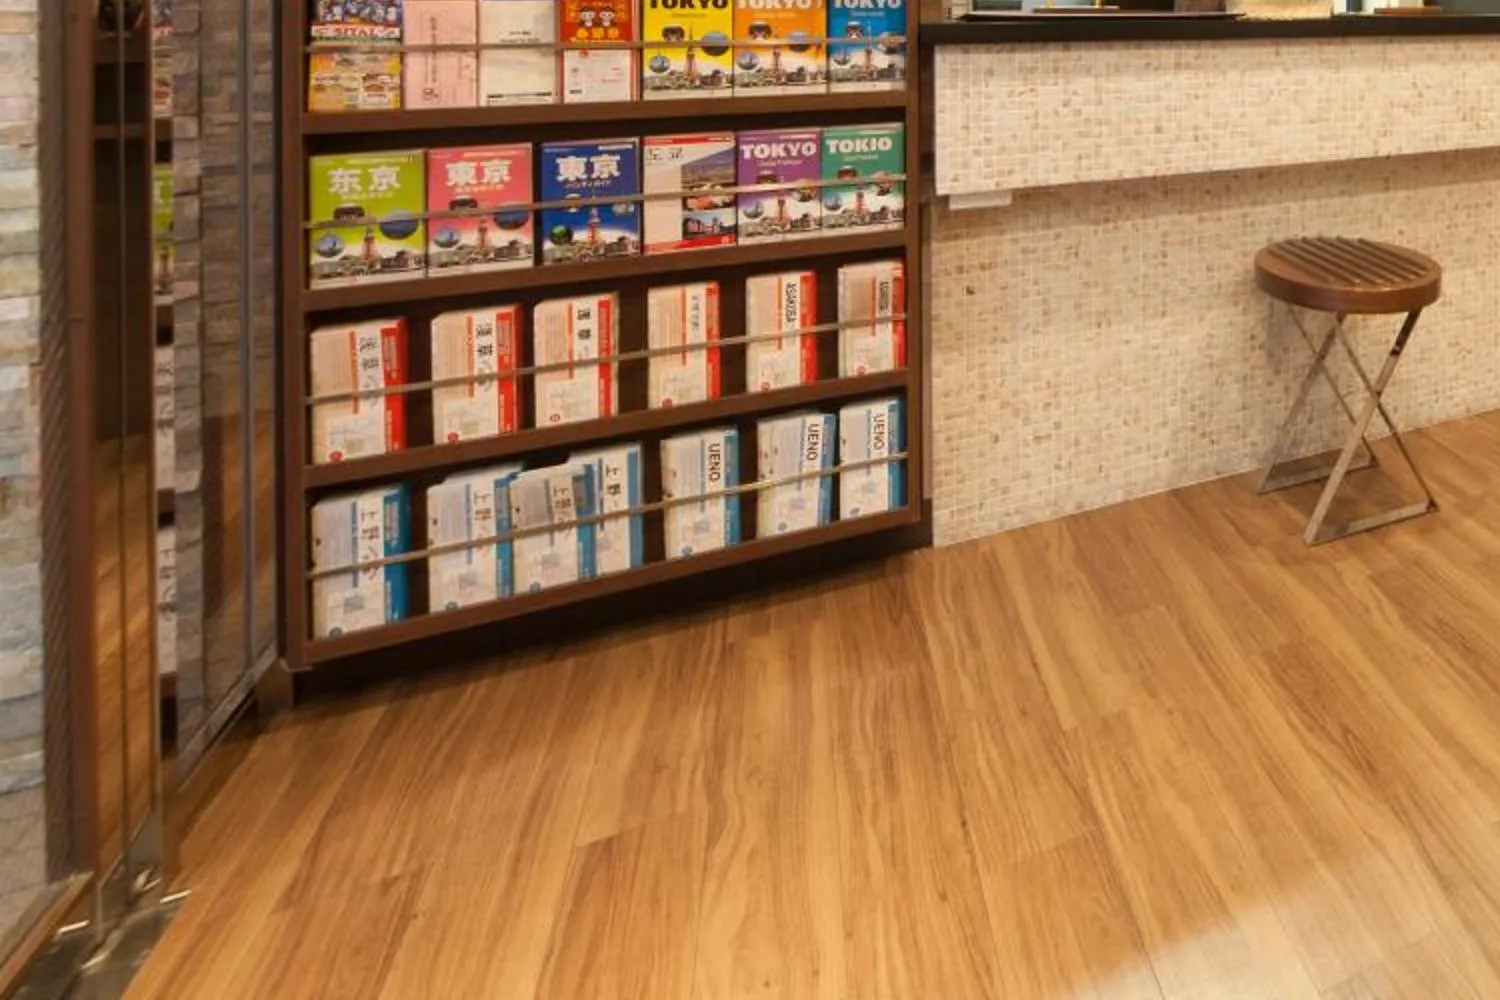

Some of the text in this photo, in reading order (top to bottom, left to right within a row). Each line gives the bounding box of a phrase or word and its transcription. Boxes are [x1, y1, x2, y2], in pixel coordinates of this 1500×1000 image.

[740, 141, 817, 160] TOKYO
[826, 136, 893, 153] TOKIO
[328, 164, 401, 194] 东京
[445, 158, 513, 187] 東京
[555, 153, 622, 182] 東京
[806, 423, 821, 461] UENO
[872, 413, 885, 450] UENO
[708, 443, 721, 481] UENO
